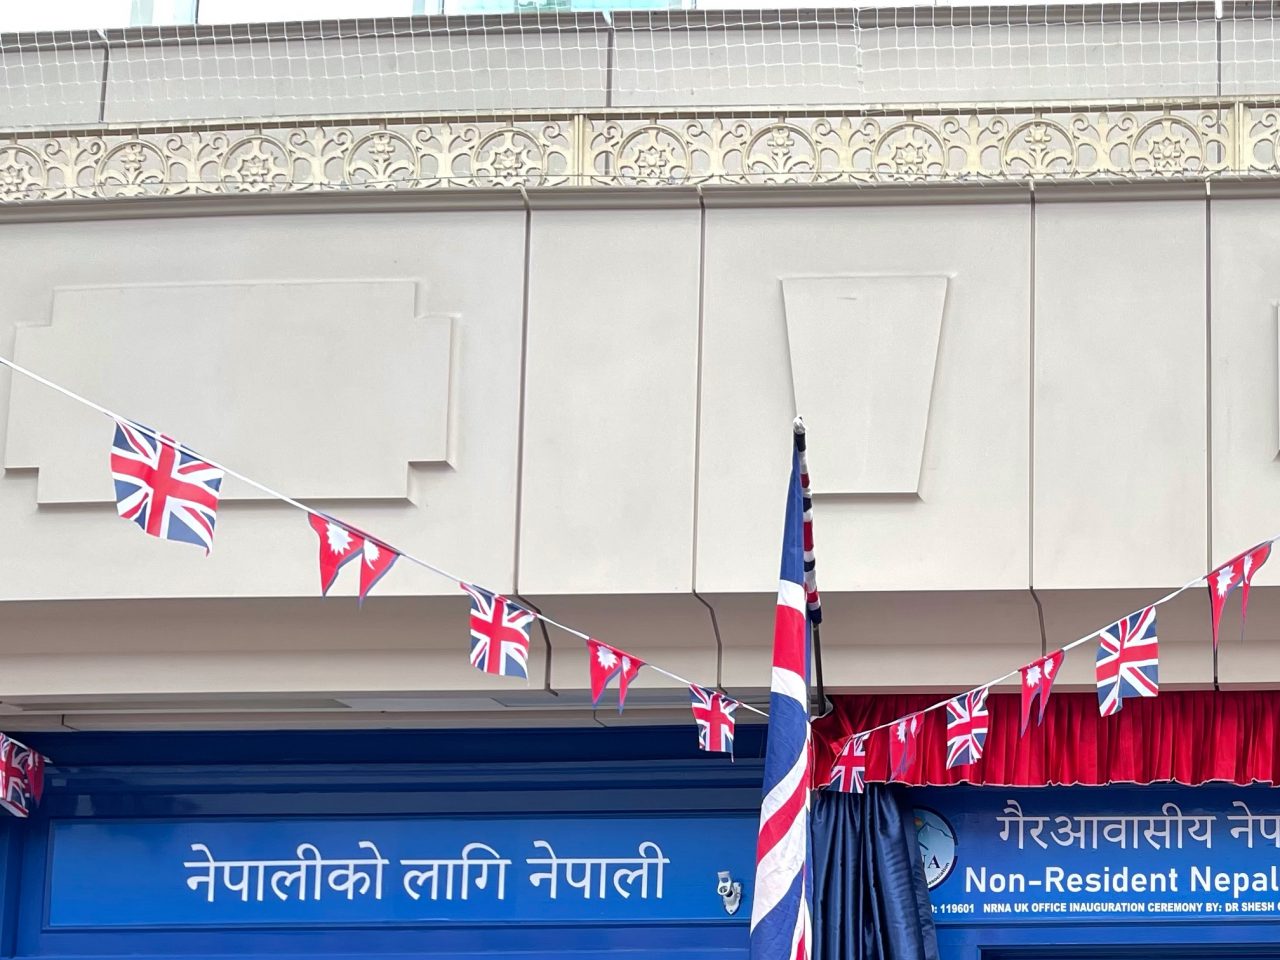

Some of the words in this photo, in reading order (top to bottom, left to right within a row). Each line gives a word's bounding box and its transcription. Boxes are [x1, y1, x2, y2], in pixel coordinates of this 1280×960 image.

[995, 799, 1217, 850] गैरआवासीय
[184, 840, 390, 902] नेपालीको
[400, 842, 512, 900] लागि
[526, 839, 671, 899] नेपाली
[965, 865, 1179, 893] Non-Resident
[941, 903, 974, 914] 119601
[983, 902, 1012, 913] NRNA
[1014, 902, 1029, 913] UK
[1031, 902, 1067, 913] OFFICE
[1069, 902, 1146, 913] INAUGURATION
[1147, 902, 1204, 913] CEREMONY
[1205, 902, 1222, 913] BY:
[1225, 902, 1239, 912] DR
[1241, 902, 1275, 912] SHESH
